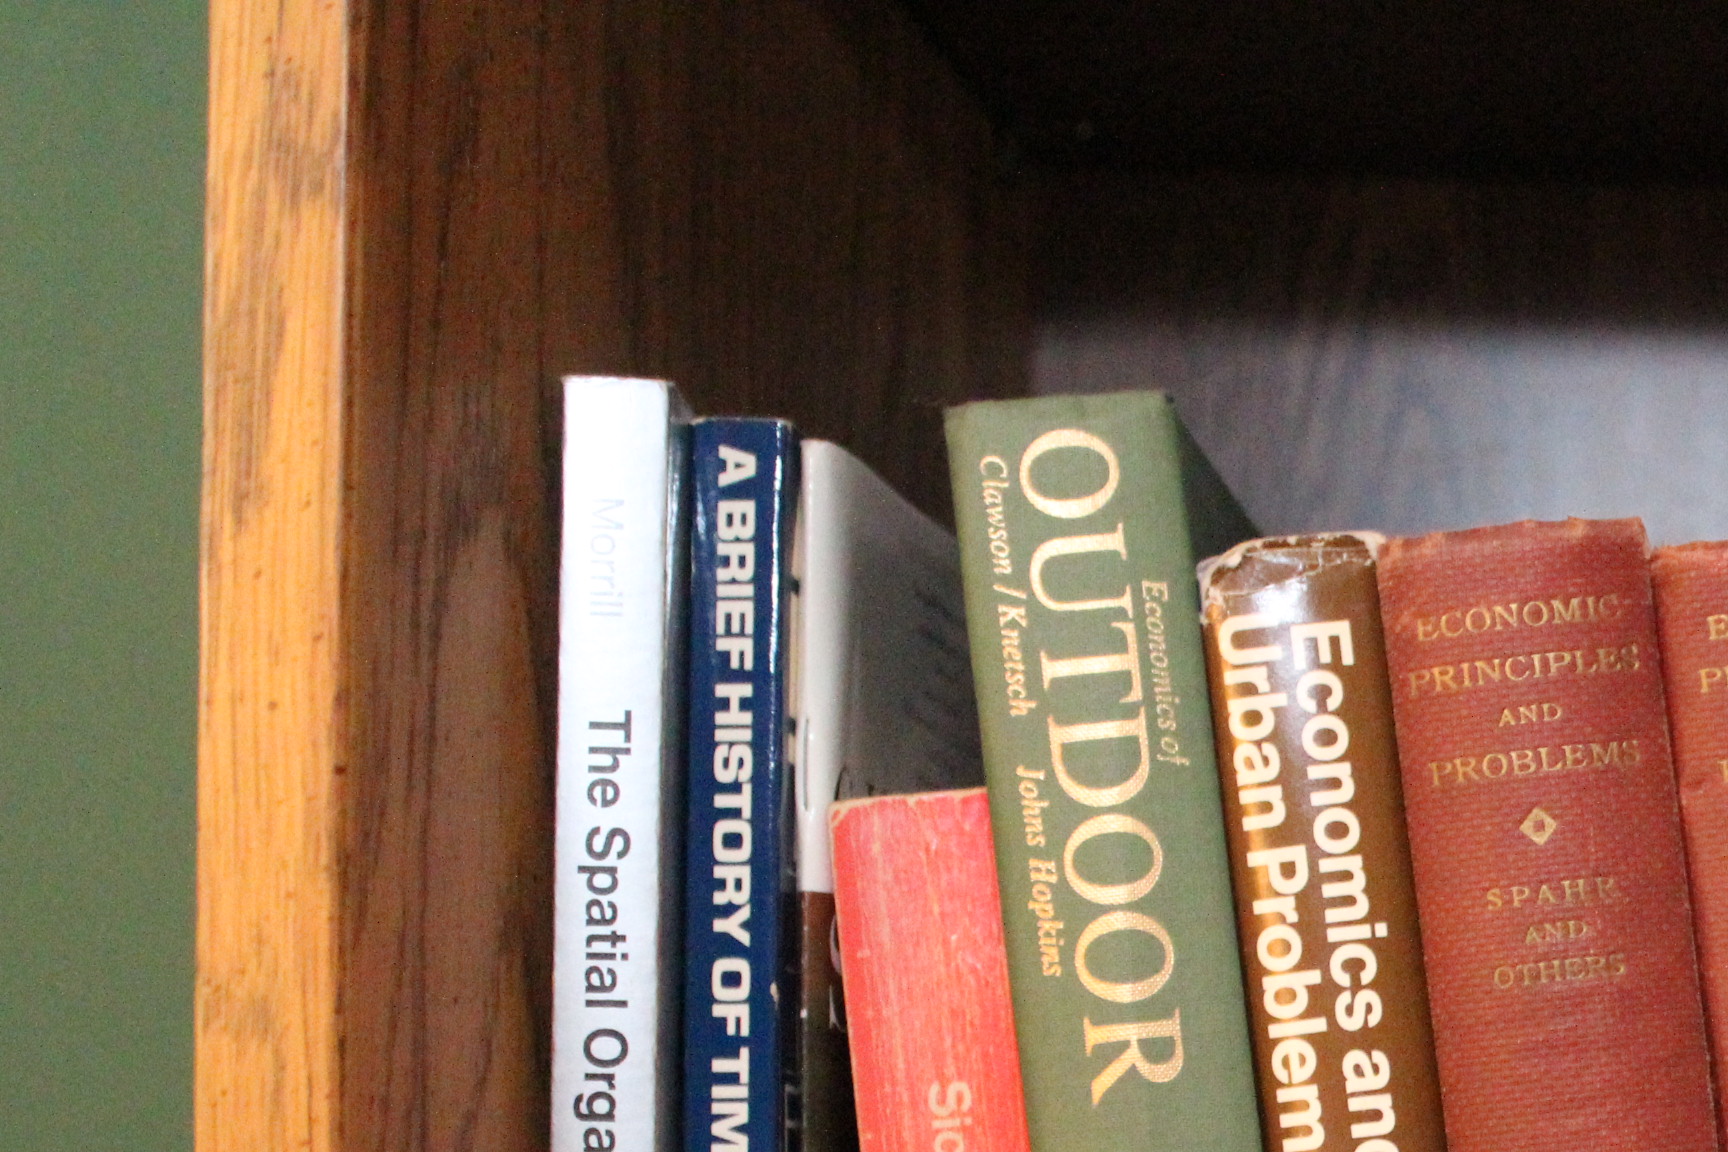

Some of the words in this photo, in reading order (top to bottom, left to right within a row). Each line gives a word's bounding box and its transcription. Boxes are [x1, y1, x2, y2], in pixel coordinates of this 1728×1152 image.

[717, 444, 757, 486] A
[589, 497, 627, 618] Morrill
[714, 500, 756, 670] BRIEF
[979, 454, 1012, 586] Clawson
[997, 602, 1038, 718] Knetsch
[1141, 580, 1181, 734] Economics
[1416, 594, 1626, 642] ECONOMIC
[1408, 645, 1641, 698] PRINCIPLES
[1498, 702, 1562, 728] AND
[587, 709, 632, 807] The
[1156, 741, 1190, 767] of
[1218, 613, 1288, 831] Urban
[1429, 740, 1642, 787] PROBLEMS
[712, 680, 755, 942] HISTORY
[1016, 765, 1051, 848] Johns
[1018, 428, 1185, 1107] OUTDOOR
[1290, 619, 1388, 1032] Economics
[577, 826, 631, 1008] Spatial
[1028, 857, 1065, 977] Hopkins
[1486, 876, 1618, 910] SPAHR
[1524, 919, 1588, 946] AND
[710, 973, 752, 1037] OF
[1492, 953, 1627, 989] OTHERS
